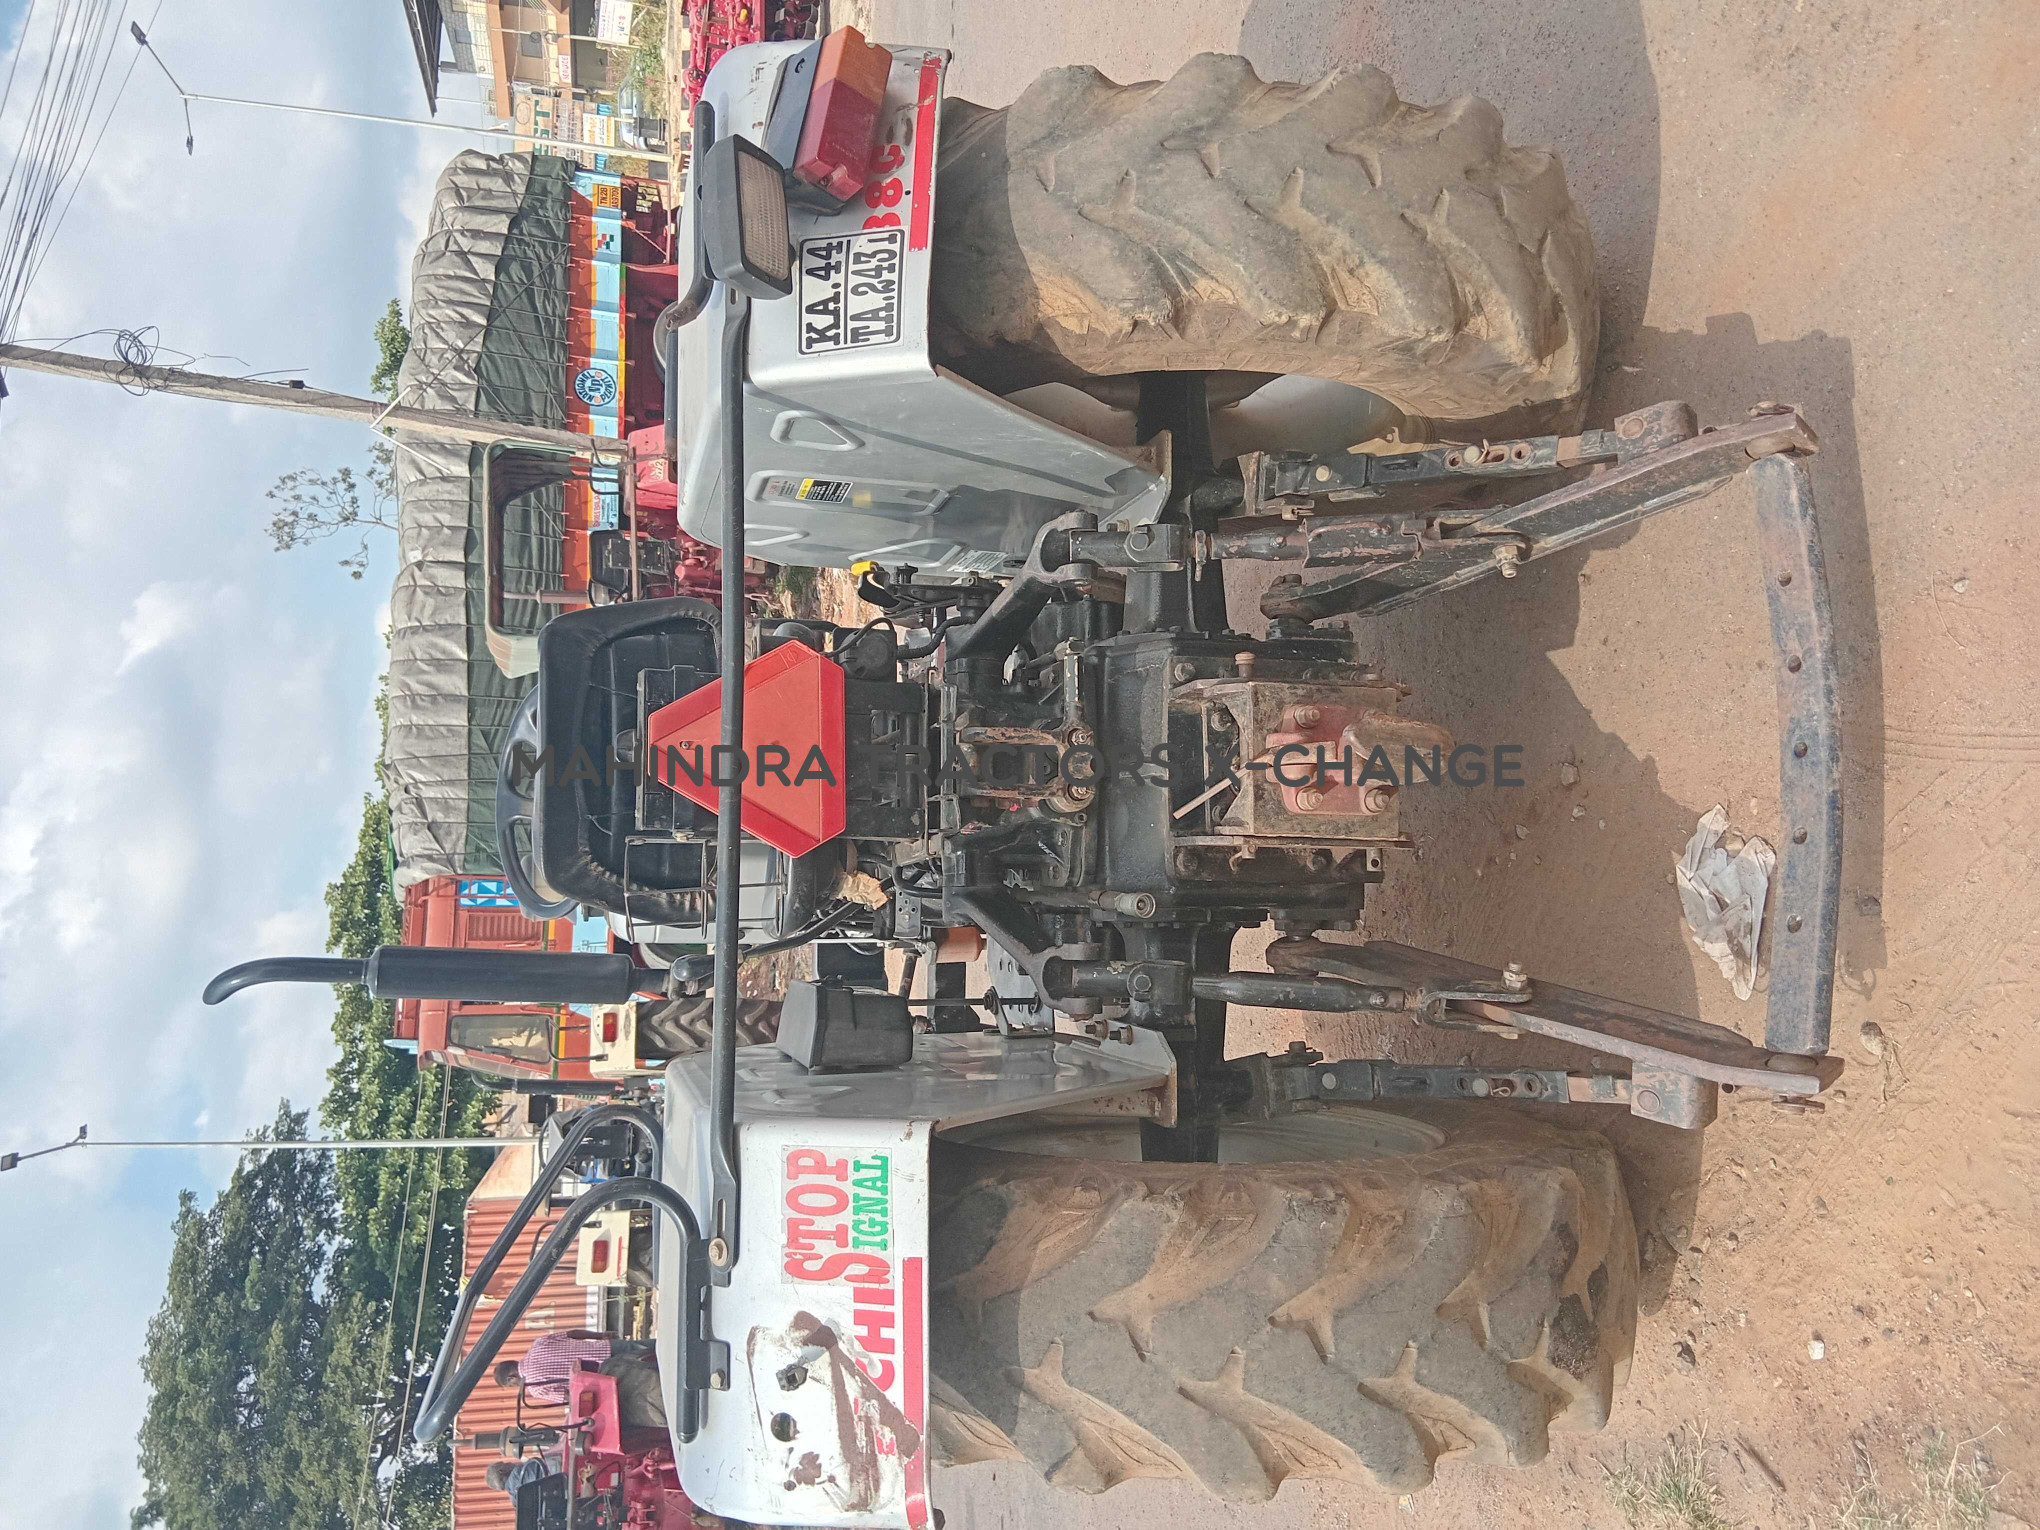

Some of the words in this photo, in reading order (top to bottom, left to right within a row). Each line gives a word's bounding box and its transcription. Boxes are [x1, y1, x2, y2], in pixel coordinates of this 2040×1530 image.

[804, 240, 844, 350] KA.44
[849, 233, 898, 344] TA.2431
[576, 371, 595, 403] NATIONAL
[600, 376, 614, 403] PERMIT
[783, 1148, 891, 1284] STOP
